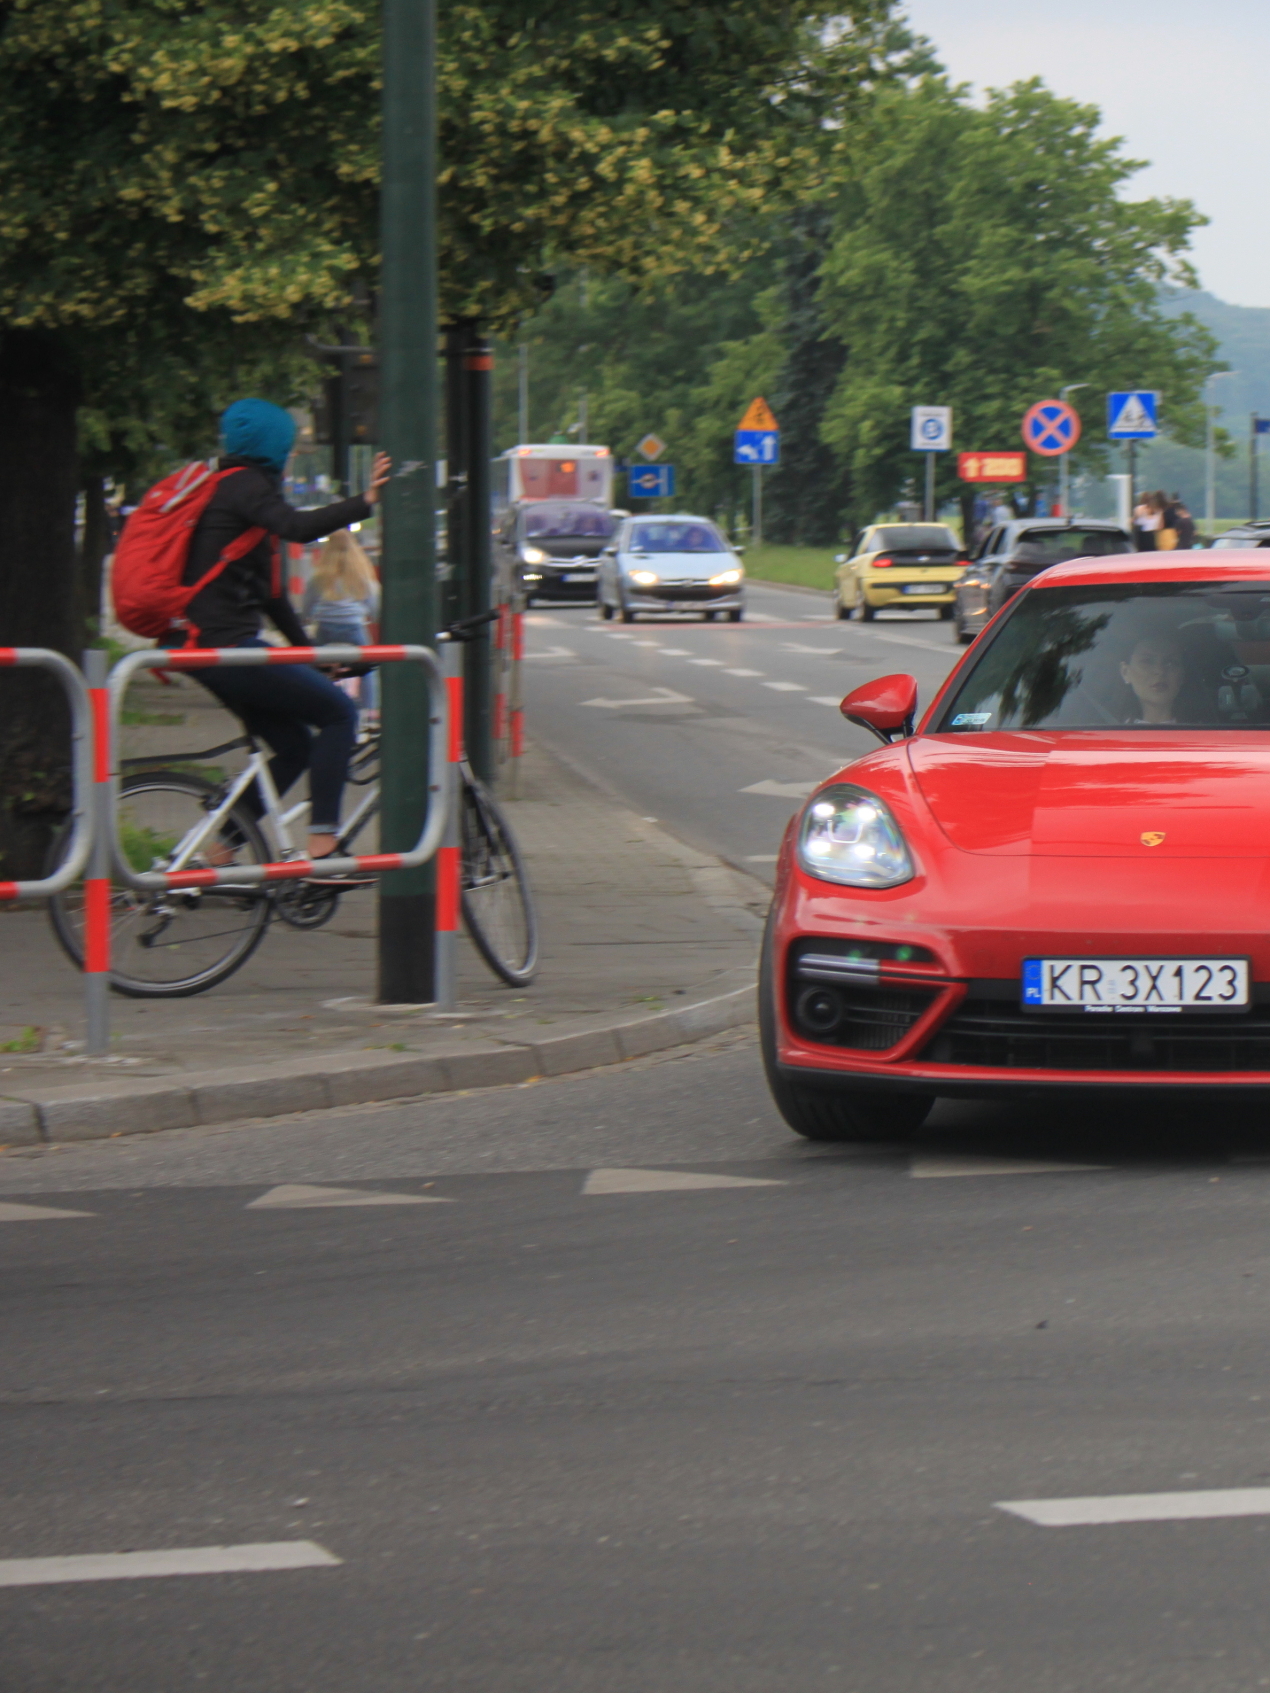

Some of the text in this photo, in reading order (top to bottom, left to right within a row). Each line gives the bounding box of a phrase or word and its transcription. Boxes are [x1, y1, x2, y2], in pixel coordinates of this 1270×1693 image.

[1026, 987, 1042, 999] PL
[1049, 964, 1238, 1001] KR 3X123
